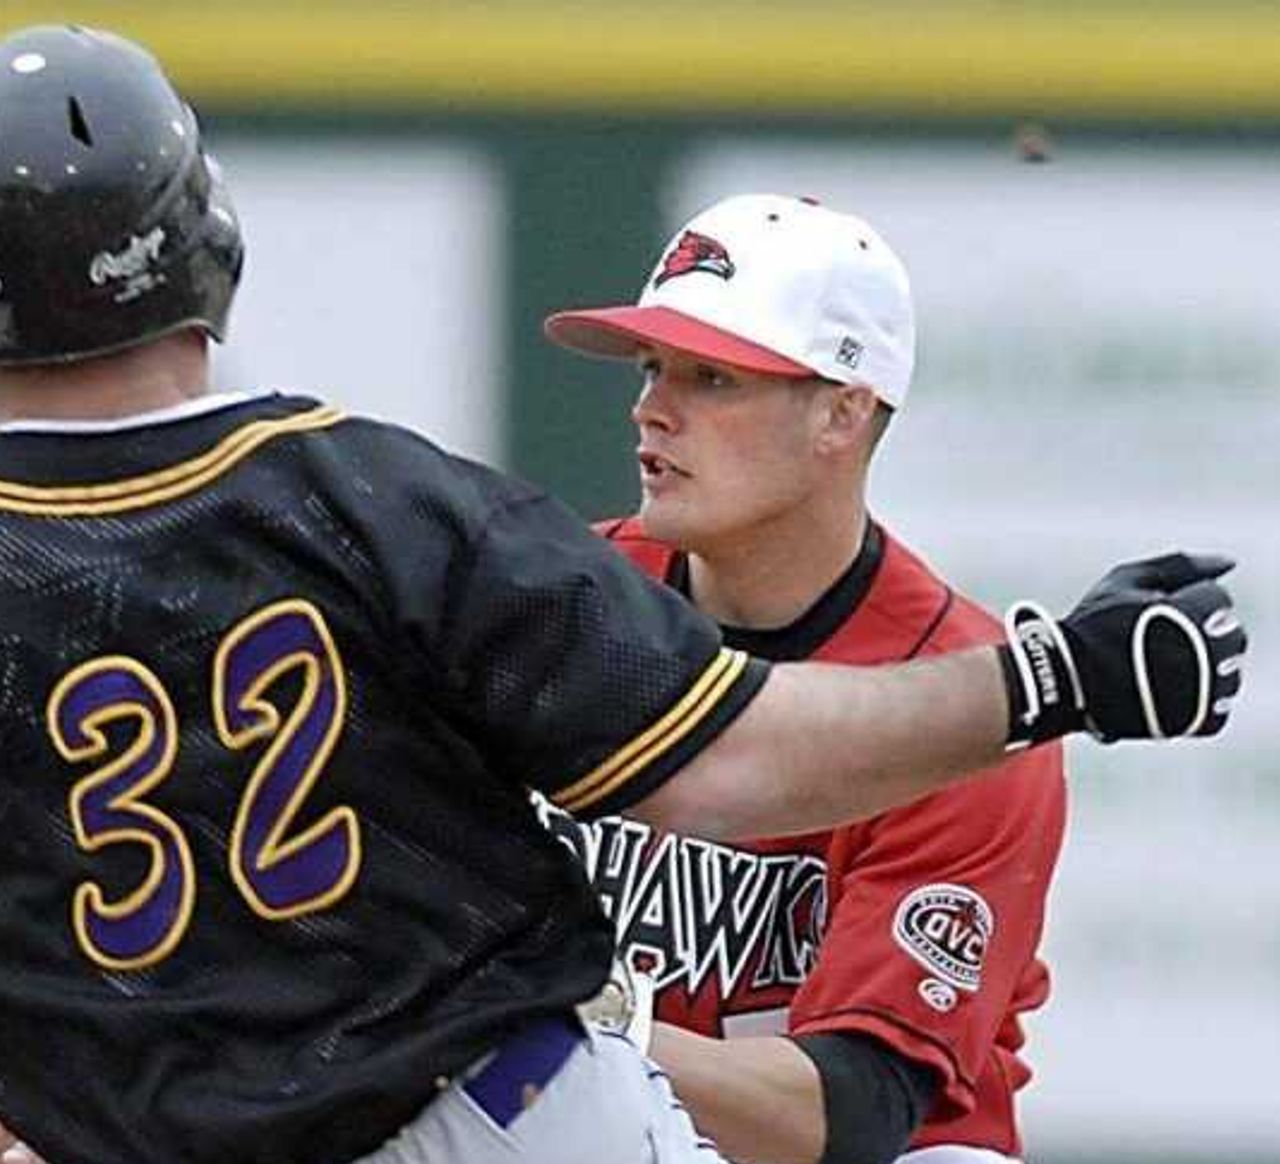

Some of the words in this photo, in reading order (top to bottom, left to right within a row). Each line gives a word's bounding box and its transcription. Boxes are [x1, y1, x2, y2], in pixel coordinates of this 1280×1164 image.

[47, 598, 362, 969] 32
[528, 788, 827, 1000] HAWK
[924, 912, 984, 961] OVC
